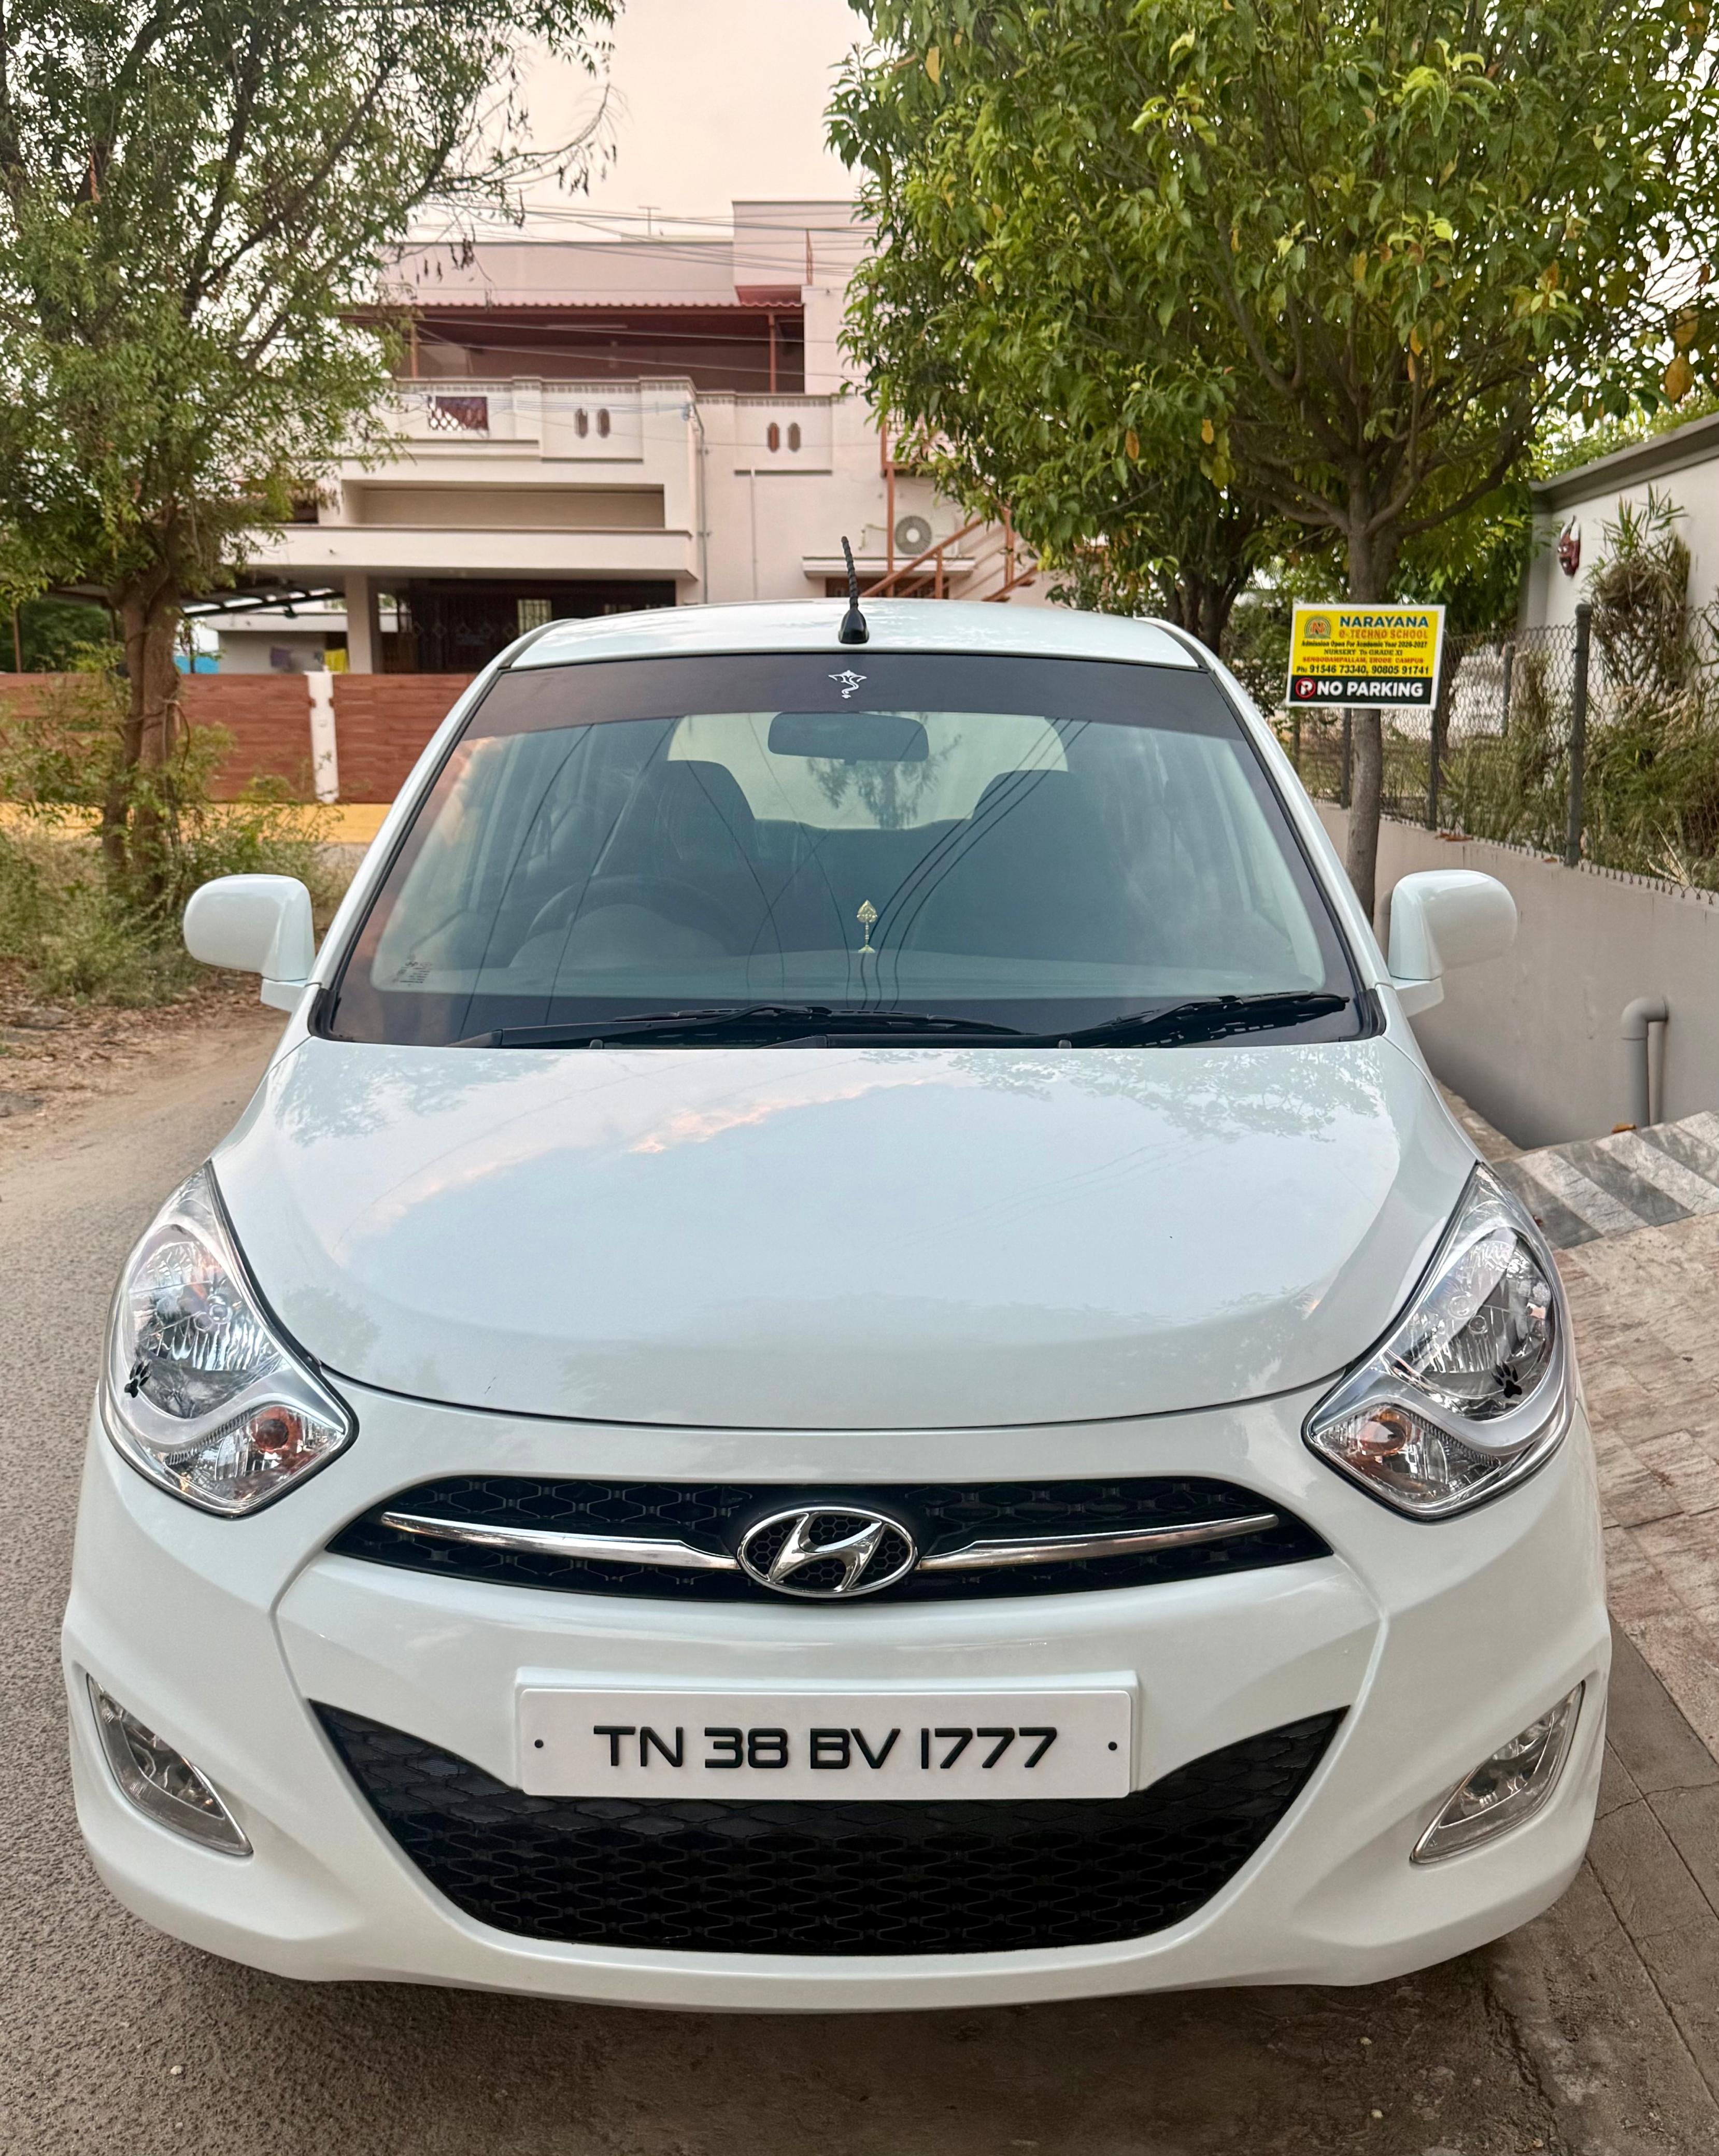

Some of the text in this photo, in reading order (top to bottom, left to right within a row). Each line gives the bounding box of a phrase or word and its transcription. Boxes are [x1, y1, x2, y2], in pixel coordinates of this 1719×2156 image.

[1340, 616, 1429, 628] NARAYANA
[1390, 630, 1428, 639] SCHOOL
[1310, 664, 1336, 673] 91546
[1340, 665, 1369, 675] 73340,
[1372, 665, 1398, 674] 90805
[1402, 666, 1429, 674] 91741
[1317, 681, 1343, 696] NO
[1347, 682, 1424, 697] PARKING
[593, 1725, 1058, 1770] TN 38 BV 1777
